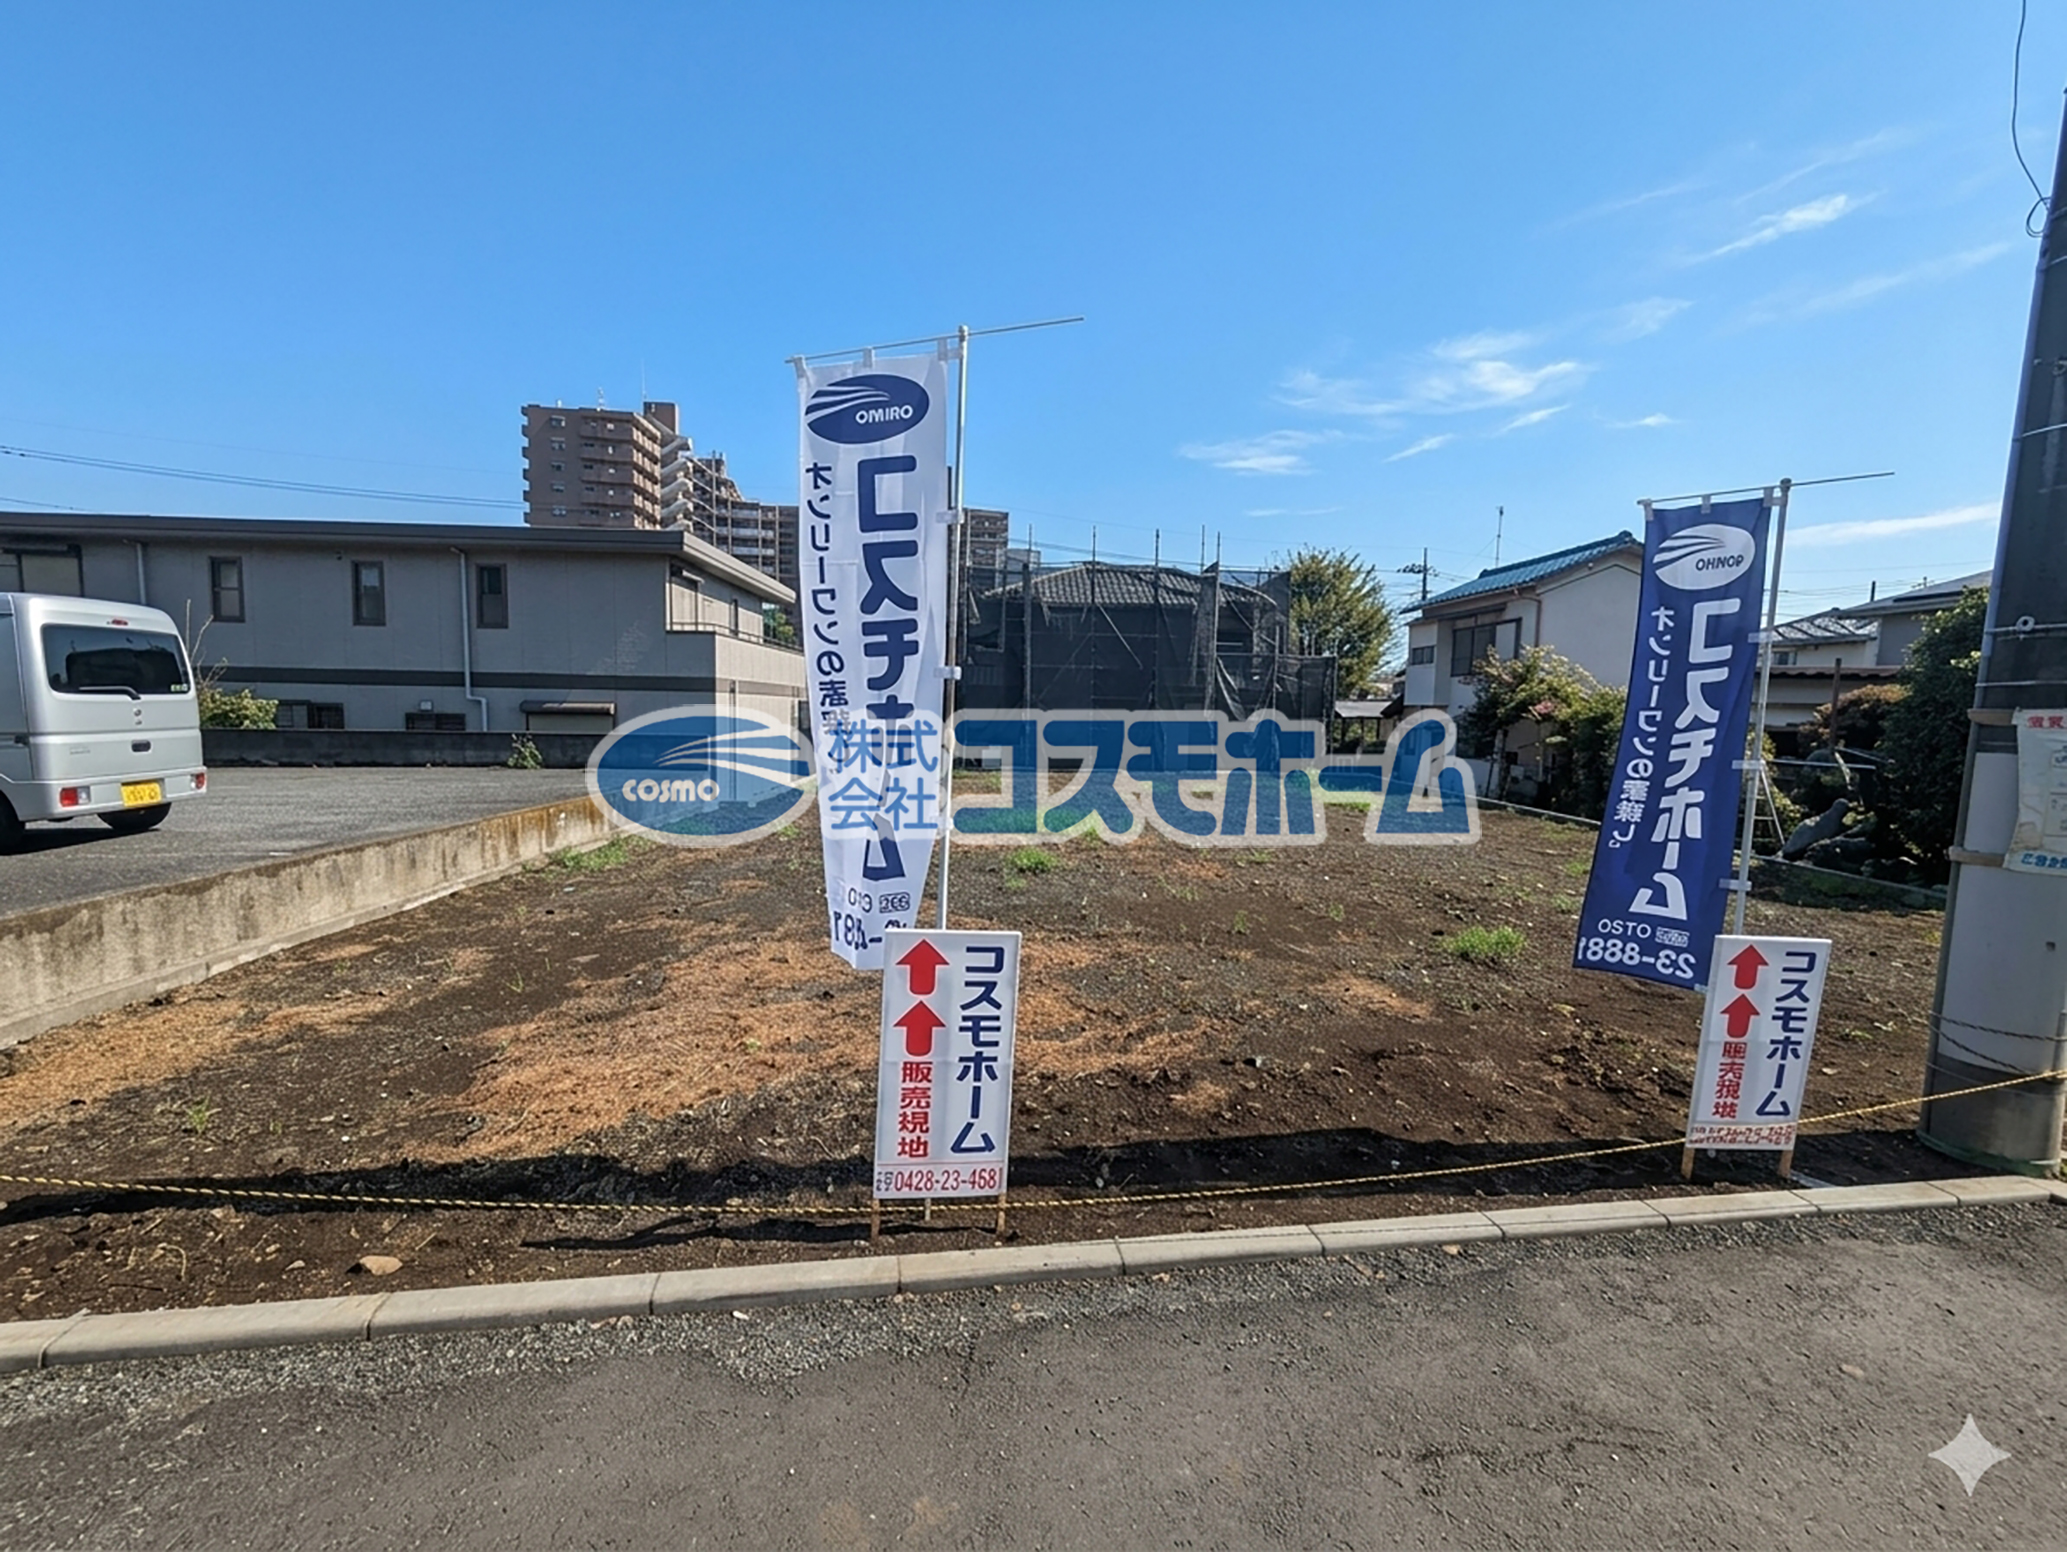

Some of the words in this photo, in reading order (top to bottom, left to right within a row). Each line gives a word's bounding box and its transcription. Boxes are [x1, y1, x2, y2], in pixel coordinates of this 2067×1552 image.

[950, 946, 1005, 1154] コスモホーム
[1755, 951, 1816, 1117] コスモホーム
